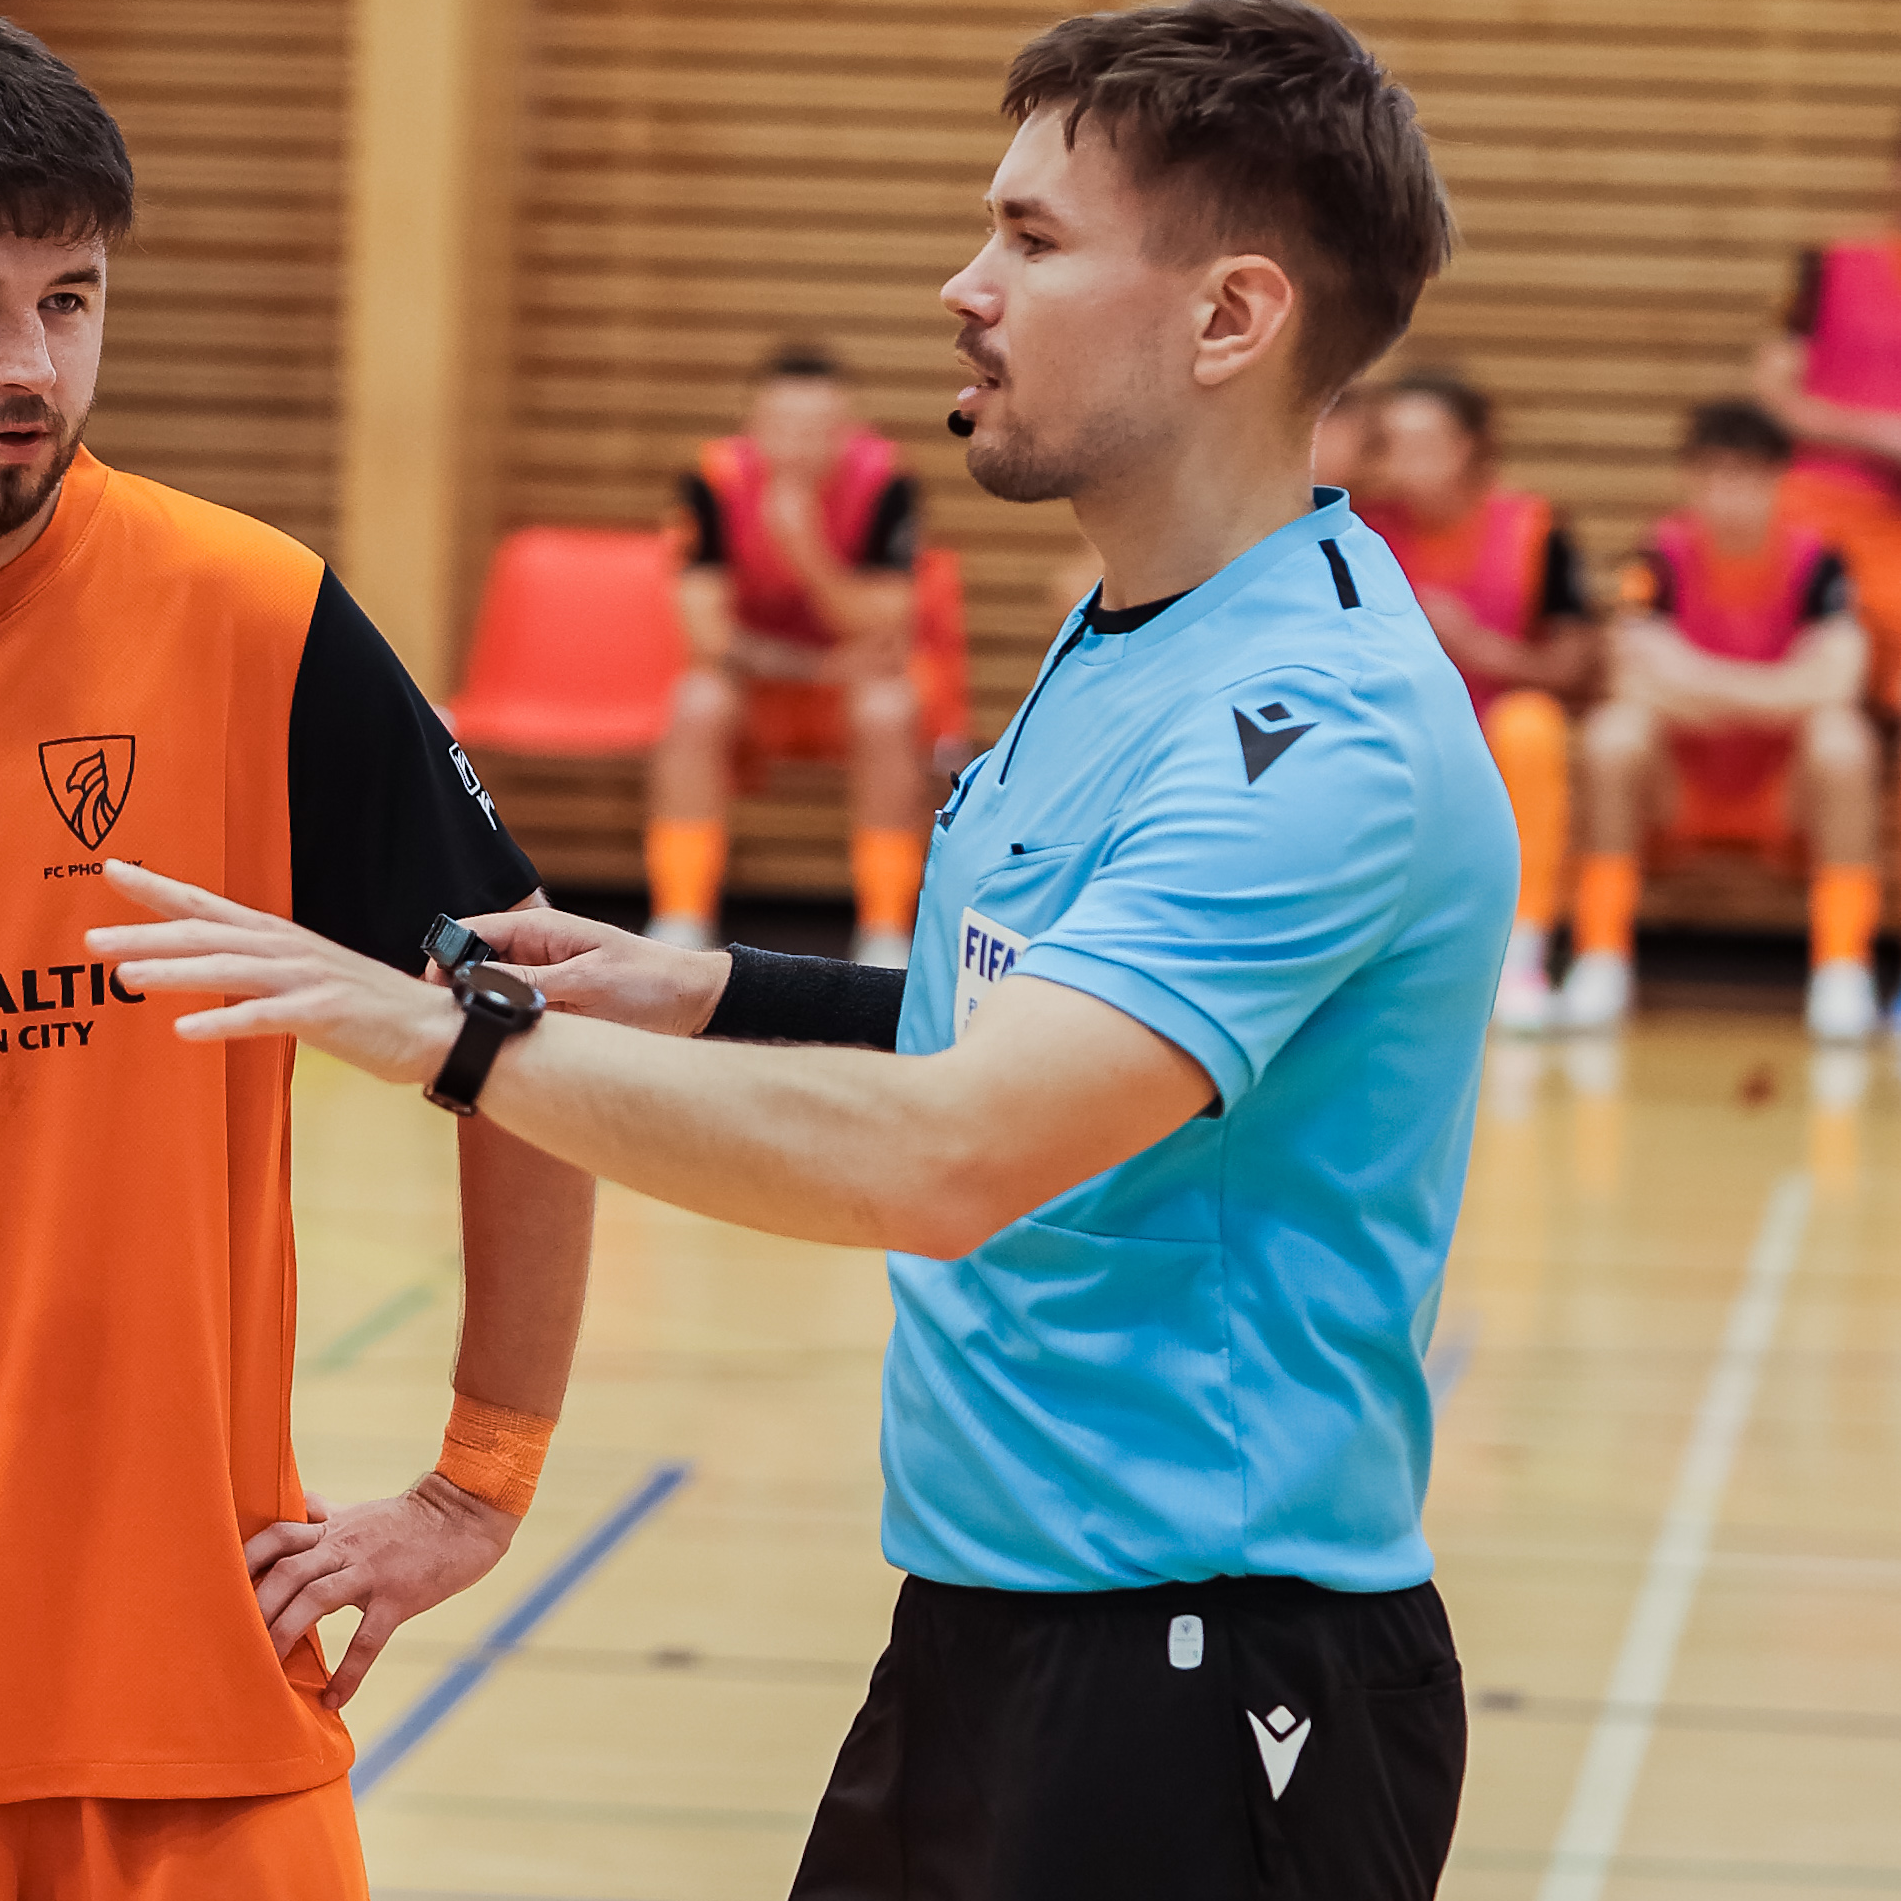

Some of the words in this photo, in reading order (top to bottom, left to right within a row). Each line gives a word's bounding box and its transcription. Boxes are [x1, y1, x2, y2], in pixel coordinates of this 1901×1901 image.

[43, 866, 65, 880] FC
[965, 923, 1016, 983] FIFA
[18, 1020, 95, 1051] CITY
